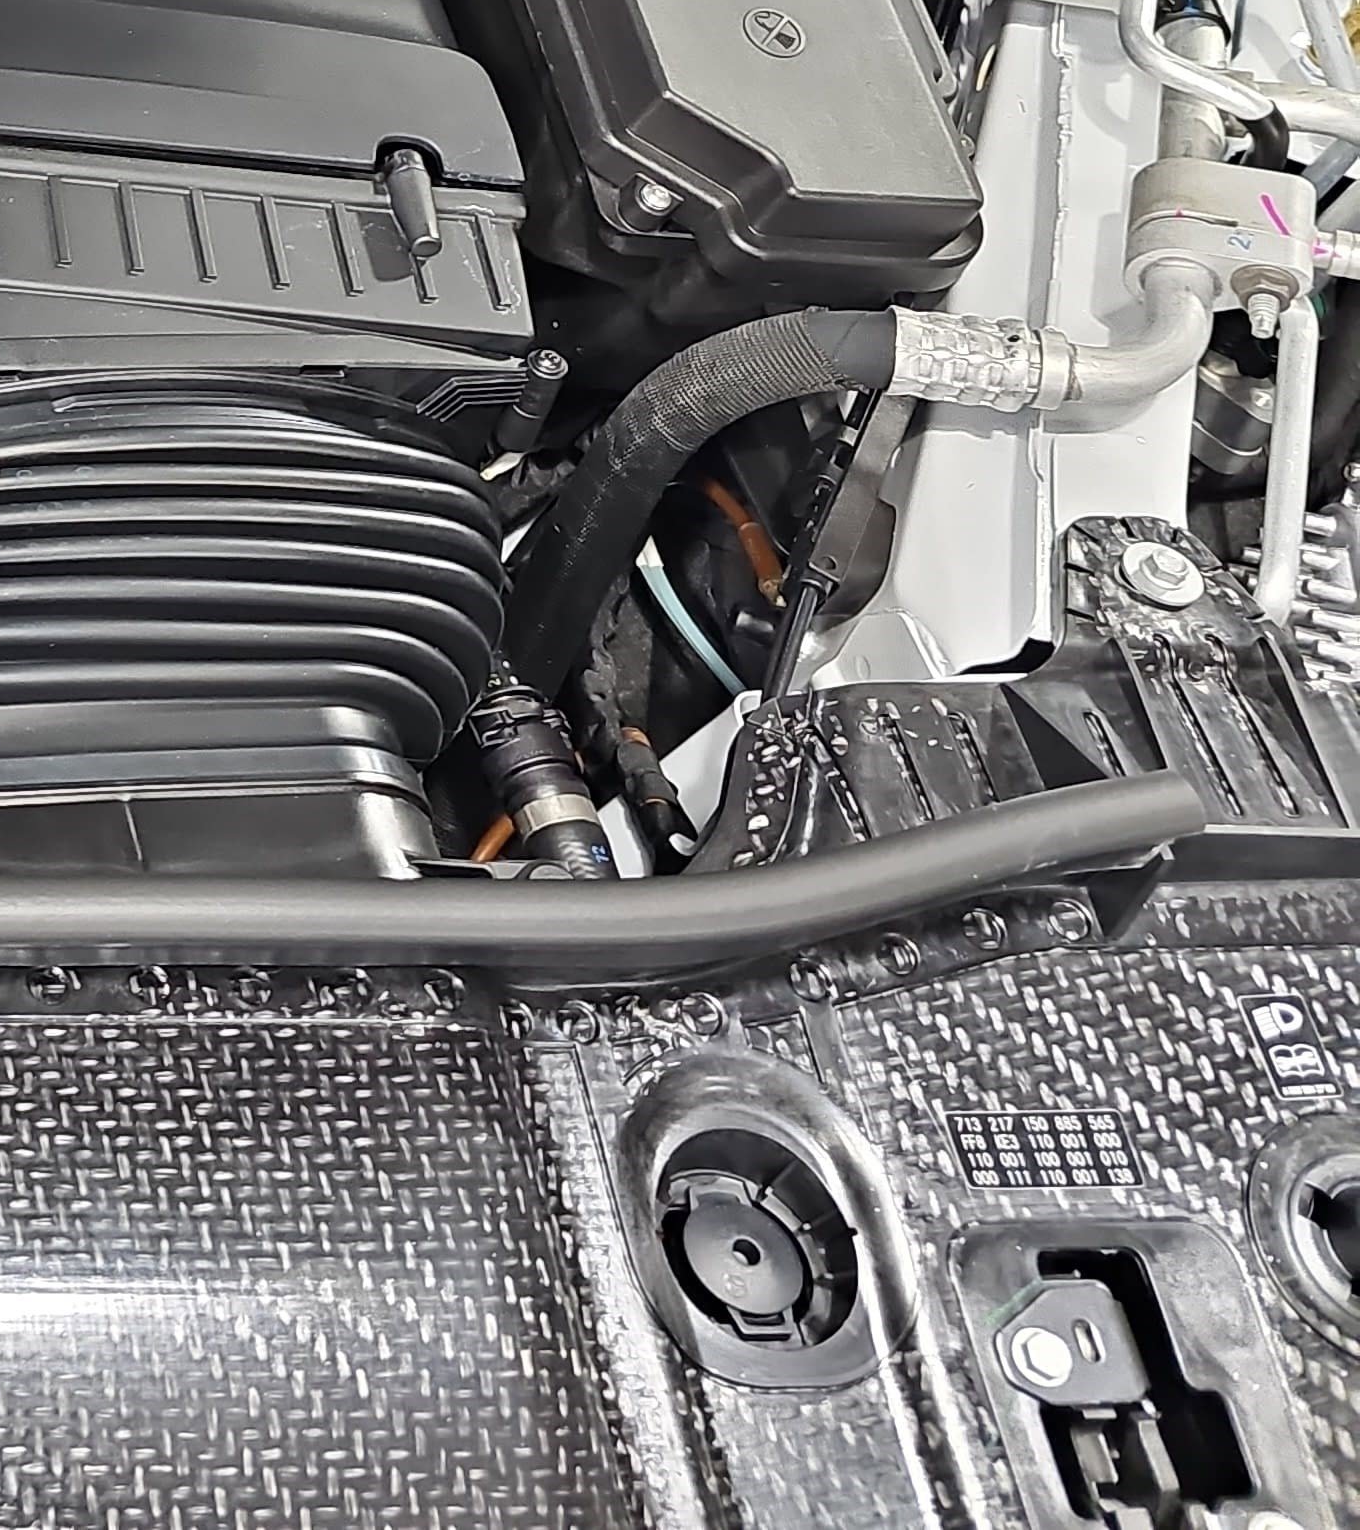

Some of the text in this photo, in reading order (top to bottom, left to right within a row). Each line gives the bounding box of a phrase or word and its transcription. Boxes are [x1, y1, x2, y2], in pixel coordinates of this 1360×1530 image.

[953, 1116, 983, 1132] 713
[987, 1116, 1014, 1132] 217
[1021, 1116, 1049, 1132] 150
[1028, 1133, 1055, 1149] 110
[1060, 1133, 1088, 1149] 001
[1093, 1132, 1122, 1149] 000
[967, 1150, 1128, 1168] 110 001 100 001 010
[972, 1169, 1000, 1185] 000
[1006, 1169, 1032, 1185] 111
[1040, 1169, 1067, 1185] 110
[1072, 1169, 1100, 1185] 001
